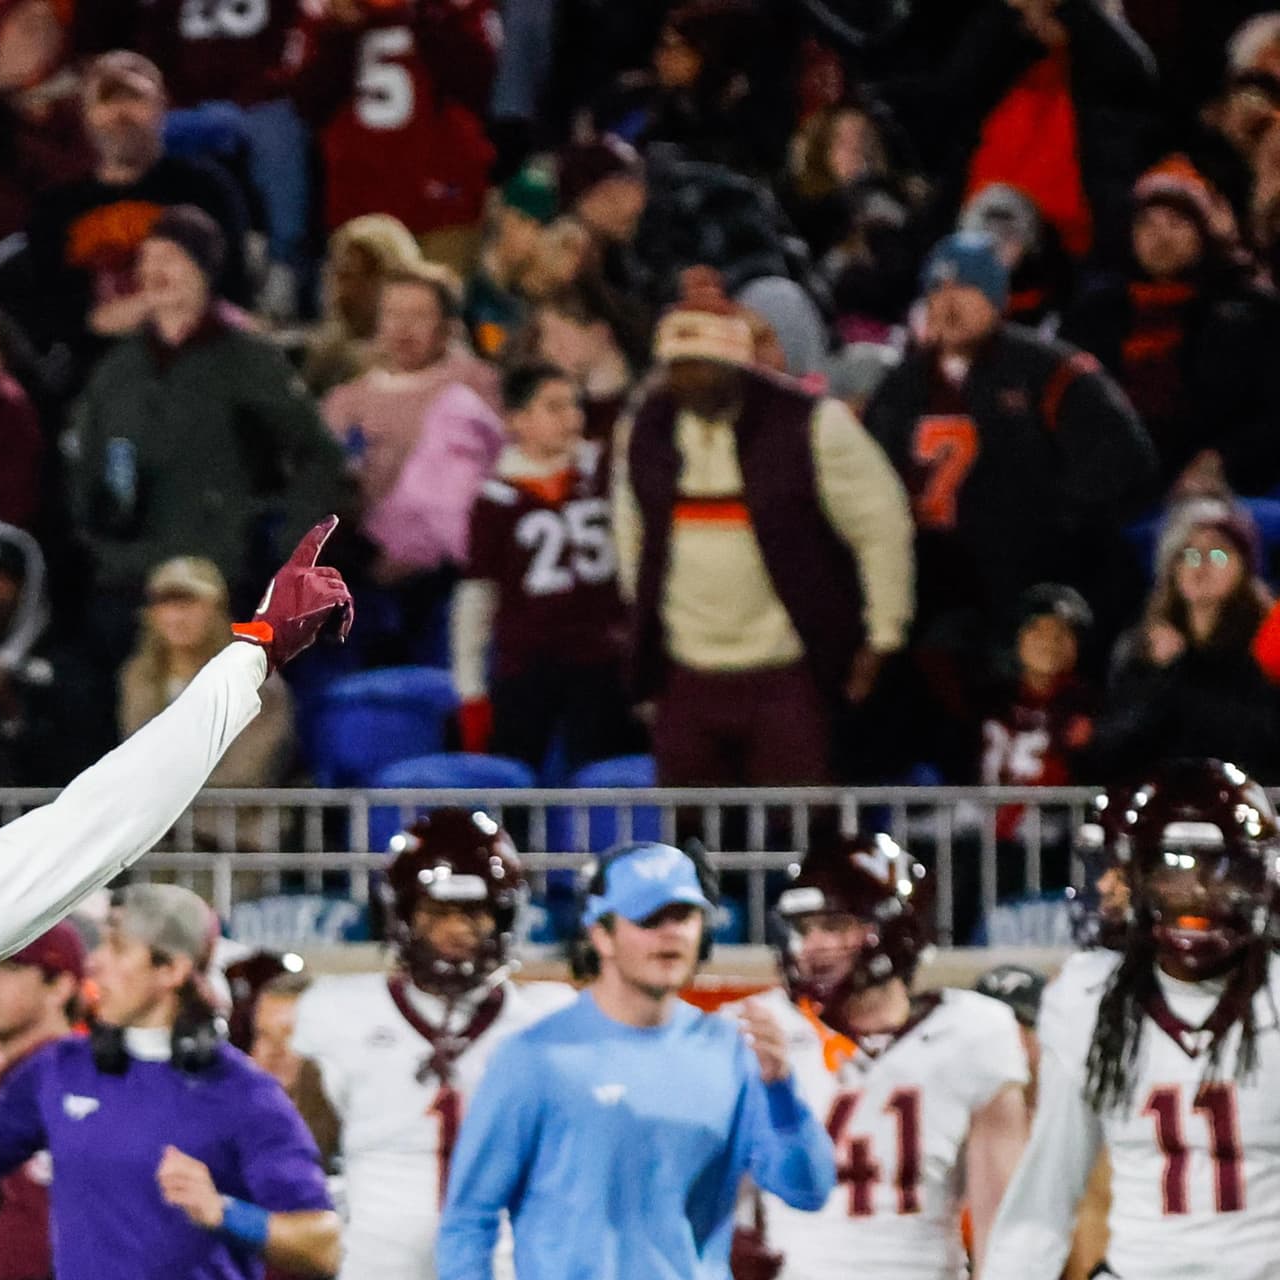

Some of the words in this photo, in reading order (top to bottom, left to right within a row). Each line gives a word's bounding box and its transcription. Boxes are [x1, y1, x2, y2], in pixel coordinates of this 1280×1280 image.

[354, 26, 416, 131] 5
[914, 415, 979, 528] 7
[515, 500, 616, 595] 25
[824, 1088, 924, 1218] 41
[1142, 1083, 1246, 1216] 11
